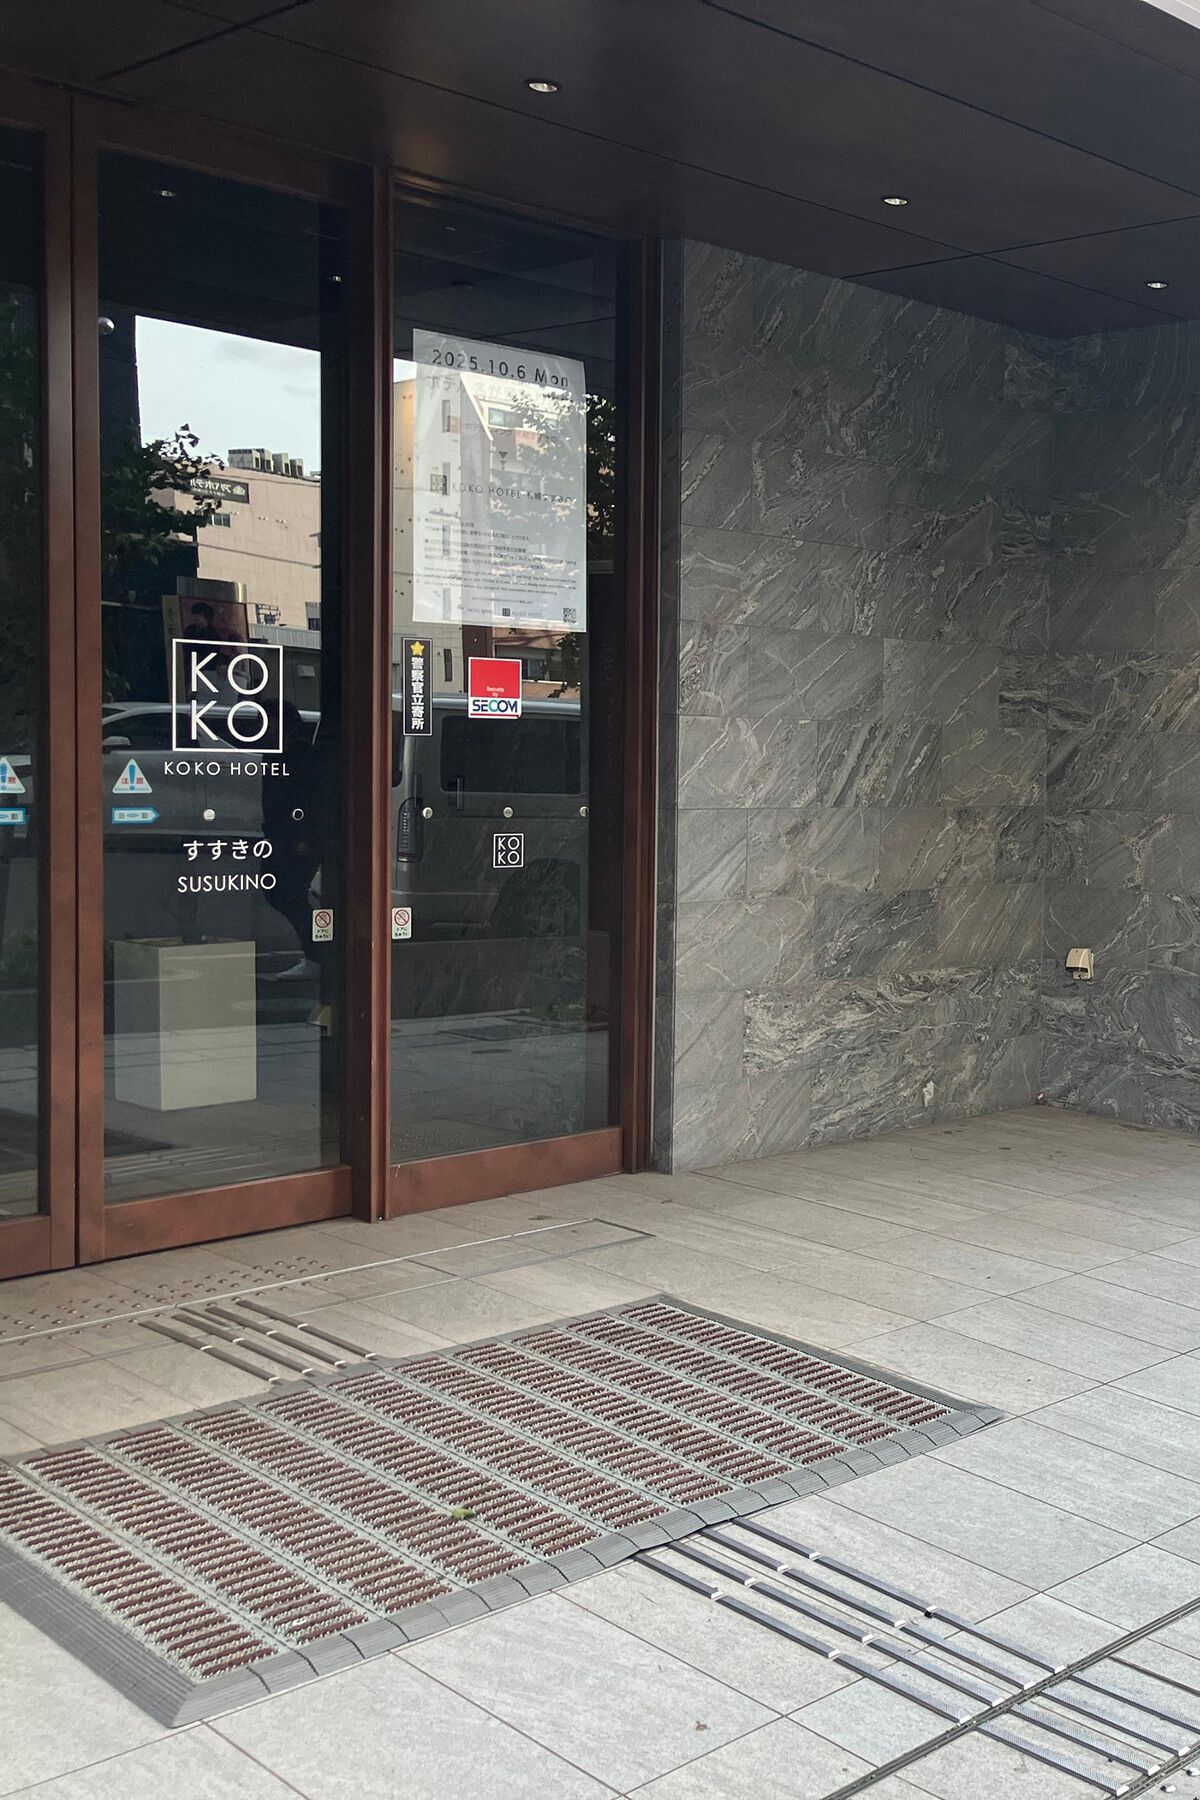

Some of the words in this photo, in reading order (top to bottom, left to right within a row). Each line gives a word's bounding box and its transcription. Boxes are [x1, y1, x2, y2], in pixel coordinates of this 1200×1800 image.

[432, 349, 527, 379] 2025.10.6
[534, 368, 569, 388] Mon
[488, 487, 521, 499] HOTEL
[192, 652, 269, 695] KO
[411, 657, 425, 730] 警察官立寄所
[472, 699, 518, 713] SECOM
[191, 700, 269, 742] KO
[164, 761, 221, 776] KOKO
[230, 762, 290, 776] HOTEL
[183, 839, 273, 861] すすきの
[498, 837, 520, 850] KO
[498, 851, 520, 864] KO
[177, 873, 277, 893] SUSUKINO
